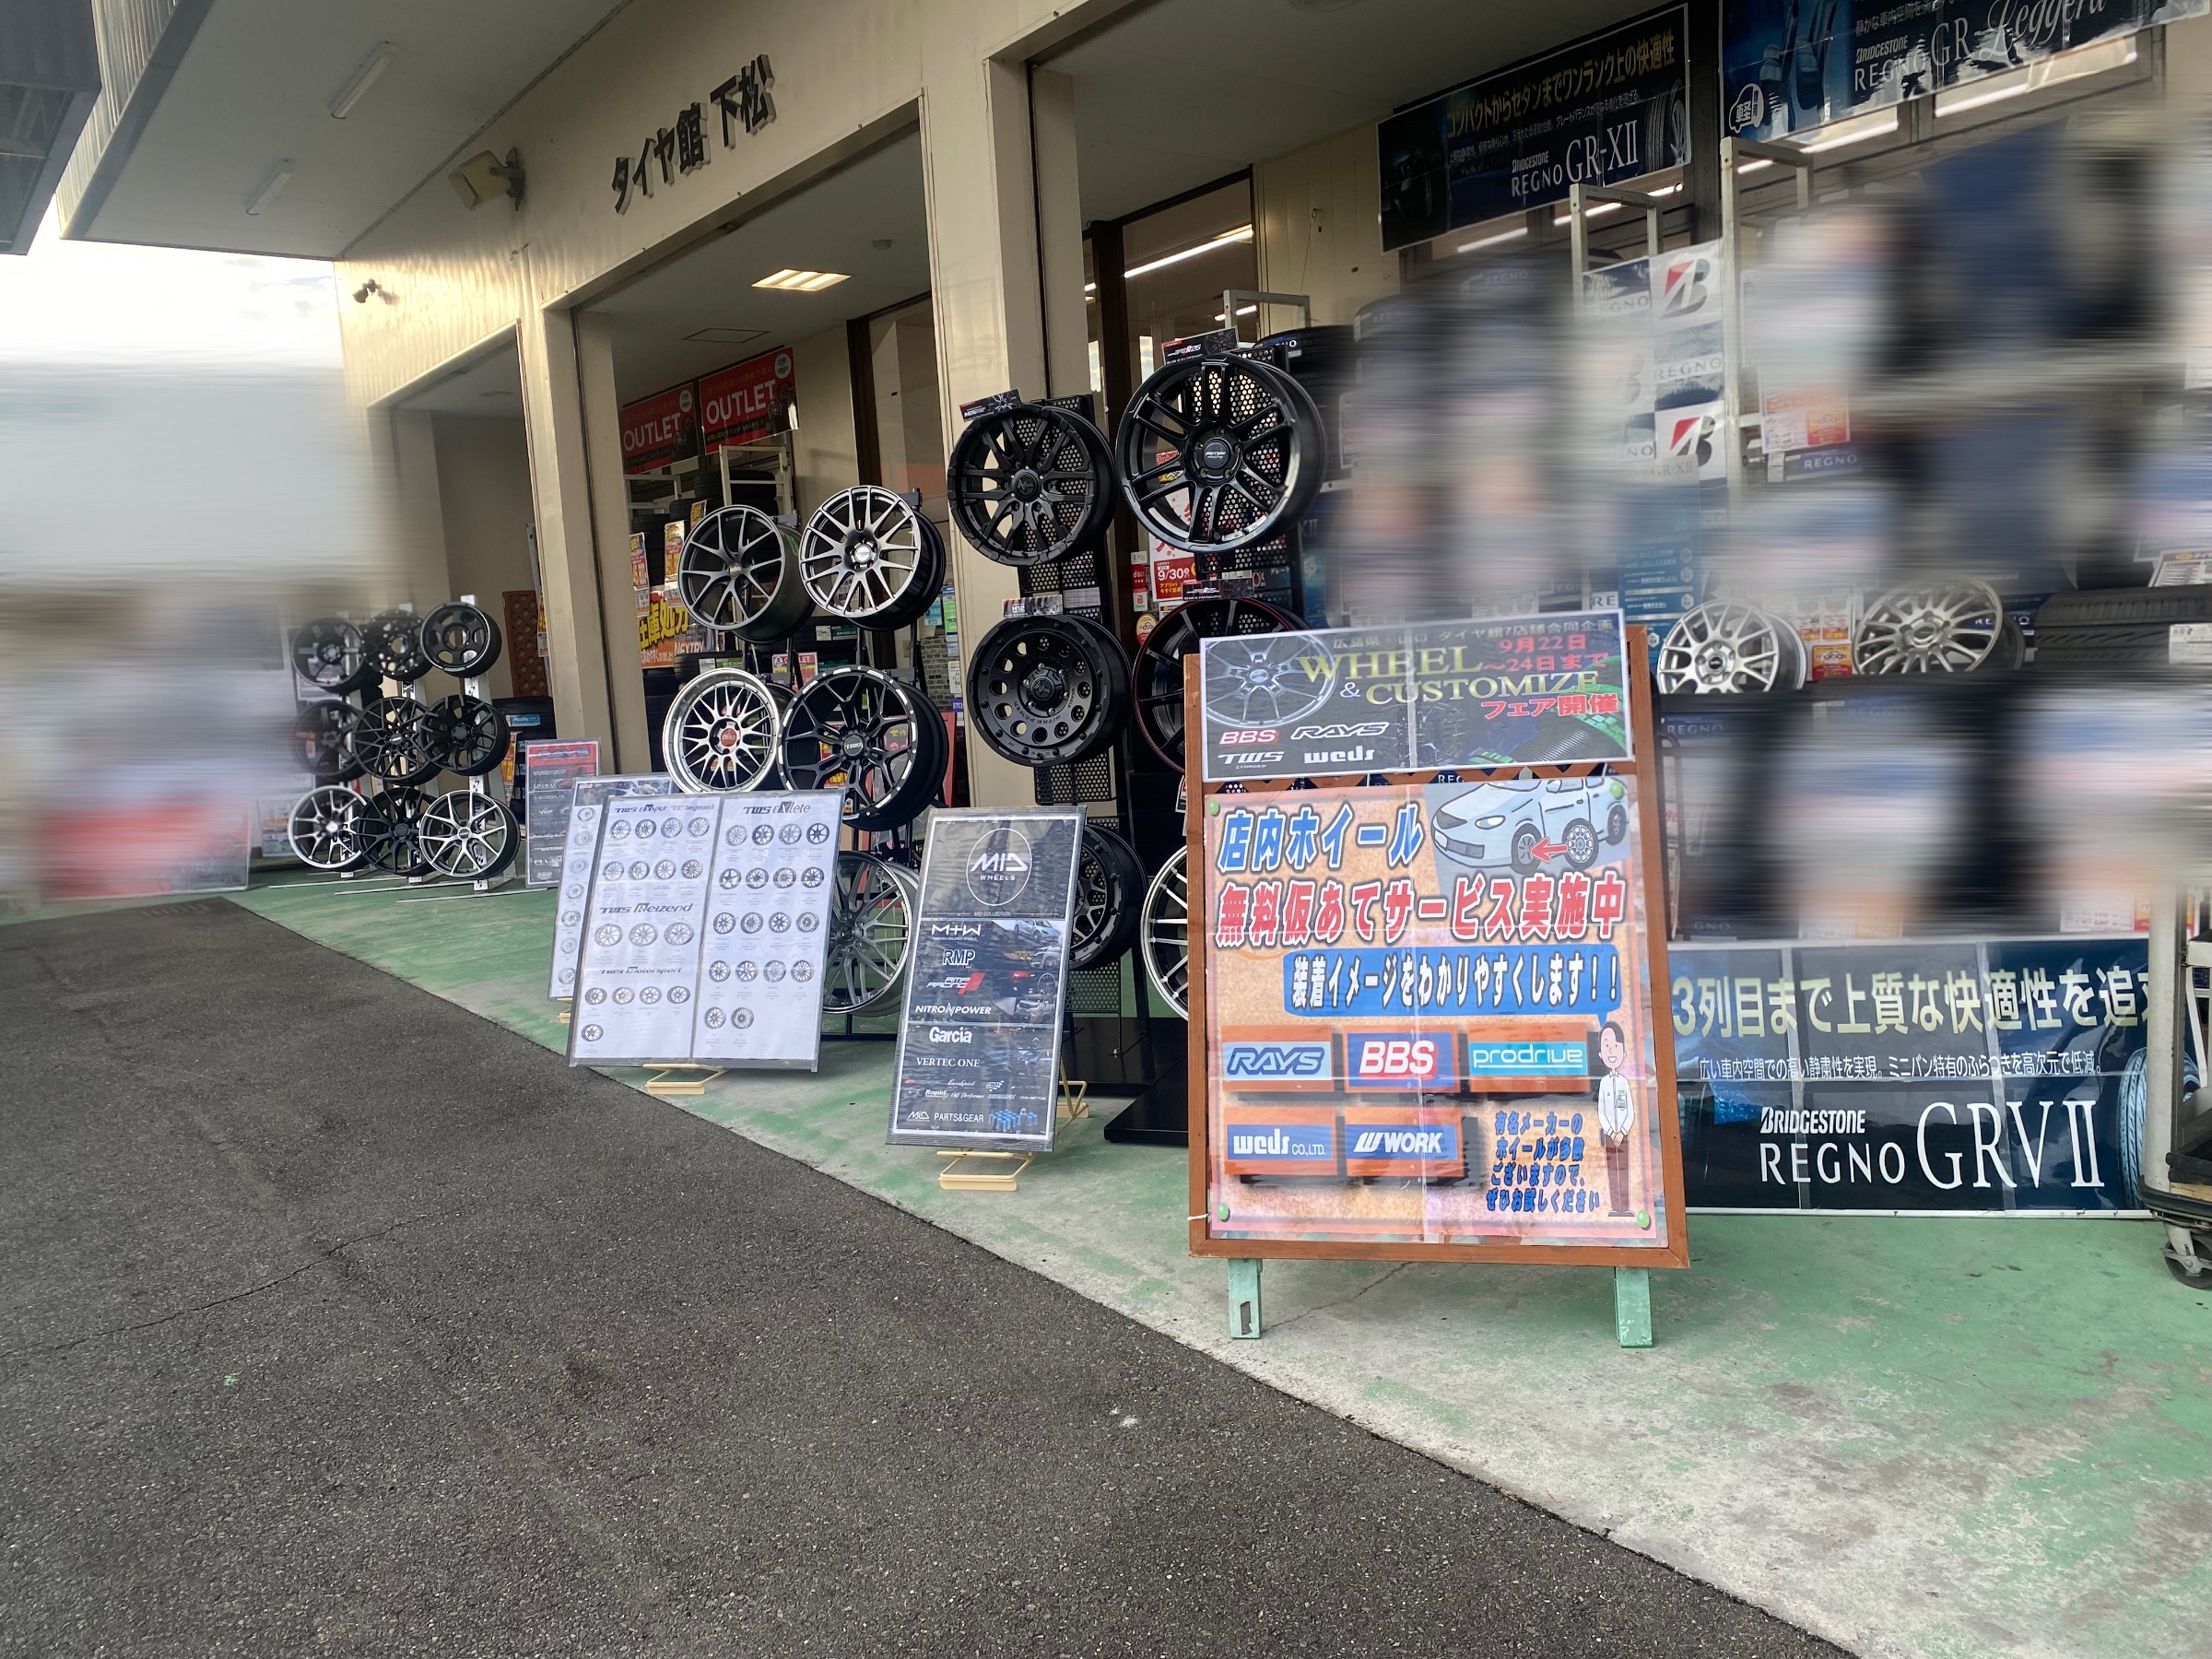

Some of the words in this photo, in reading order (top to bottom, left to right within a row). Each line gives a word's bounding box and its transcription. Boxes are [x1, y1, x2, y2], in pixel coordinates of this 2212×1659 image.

[1855, 34, 1908, 65] BRIDGESTONE
[1447, 28, 1676, 138] コンパクトからセダンまでワンランク上の快適性
[1735, 100, 1751, 123] 軽
[612, 100, 712, 216] タイヤ館
[710, 53, 776, 150] 下松
[1512, 150, 1549, 173] BRIDGESTONE
[1512, 163, 1563, 197] REGNO
[706, 379, 776, 425] OUTLET
[623, 412, 681, 453] OUTLET
[1158, 569, 1184, 582] 9/30
[1500, 634, 1587, 653] 9月22日
[1296, 646, 1483, 683] WHEEL
[1339, 682, 1361, 700] &
[1365, 671, 1600, 705] CUSTOMIZE
[1480, 694, 1619, 720] フェア開催
[1219, 729, 1278, 746] BBS
[1290, 722, 1389, 741] RAYS
[1218, 751, 1285, 766] TWS
[1304, 745, 1375, 765] weds
[743, 806, 772, 815] TWS
[1217, 800, 1424, 873] 店内ホイール
[1215, 869, 1628, 948] 無料仮あてサービス実施中
[942, 949, 976, 966] RMP
[1291, 951, 1619, 1010] 装着イメージをわかりやすくします！！
[1673, 964, 2148, 1038] 3列目まで上質な快適性を追
[929, 1026, 972, 1043] Garcia
[916, 1057, 956, 1067] VERTEC
[958, 1059, 981, 1068] ONE
[1229, 1046, 1324, 1076] RAYS
[1359, 1040, 1438, 1079] BBS
[1473, 1045, 1583, 1068] prodrive
[1699, 1056, 1884, 1081] 広い車内空間での高い静粛性を実現。
[1888, 1050, 2105, 1078] ミニバン特有のふらつきを高次元で低減。
[934, 1112, 984, 1123] PARTS&GEAR
[1495, 1111, 1583, 1135] 有名メーカーの
[1759, 1107, 1865, 1135] BRIDGESTONE
[1232, 1128, 1289, 1156] weds
[1384, 1131, 1443, 1154] WORK
[1496, 1136, 1585, 1161] ホイールが多数
[1490, 1161, 1585, 1188] ございますので、
[1759, 1142, 1906, 1185] REGNO
[1486, 1186, 1601, 1213] ぜひお試しください
